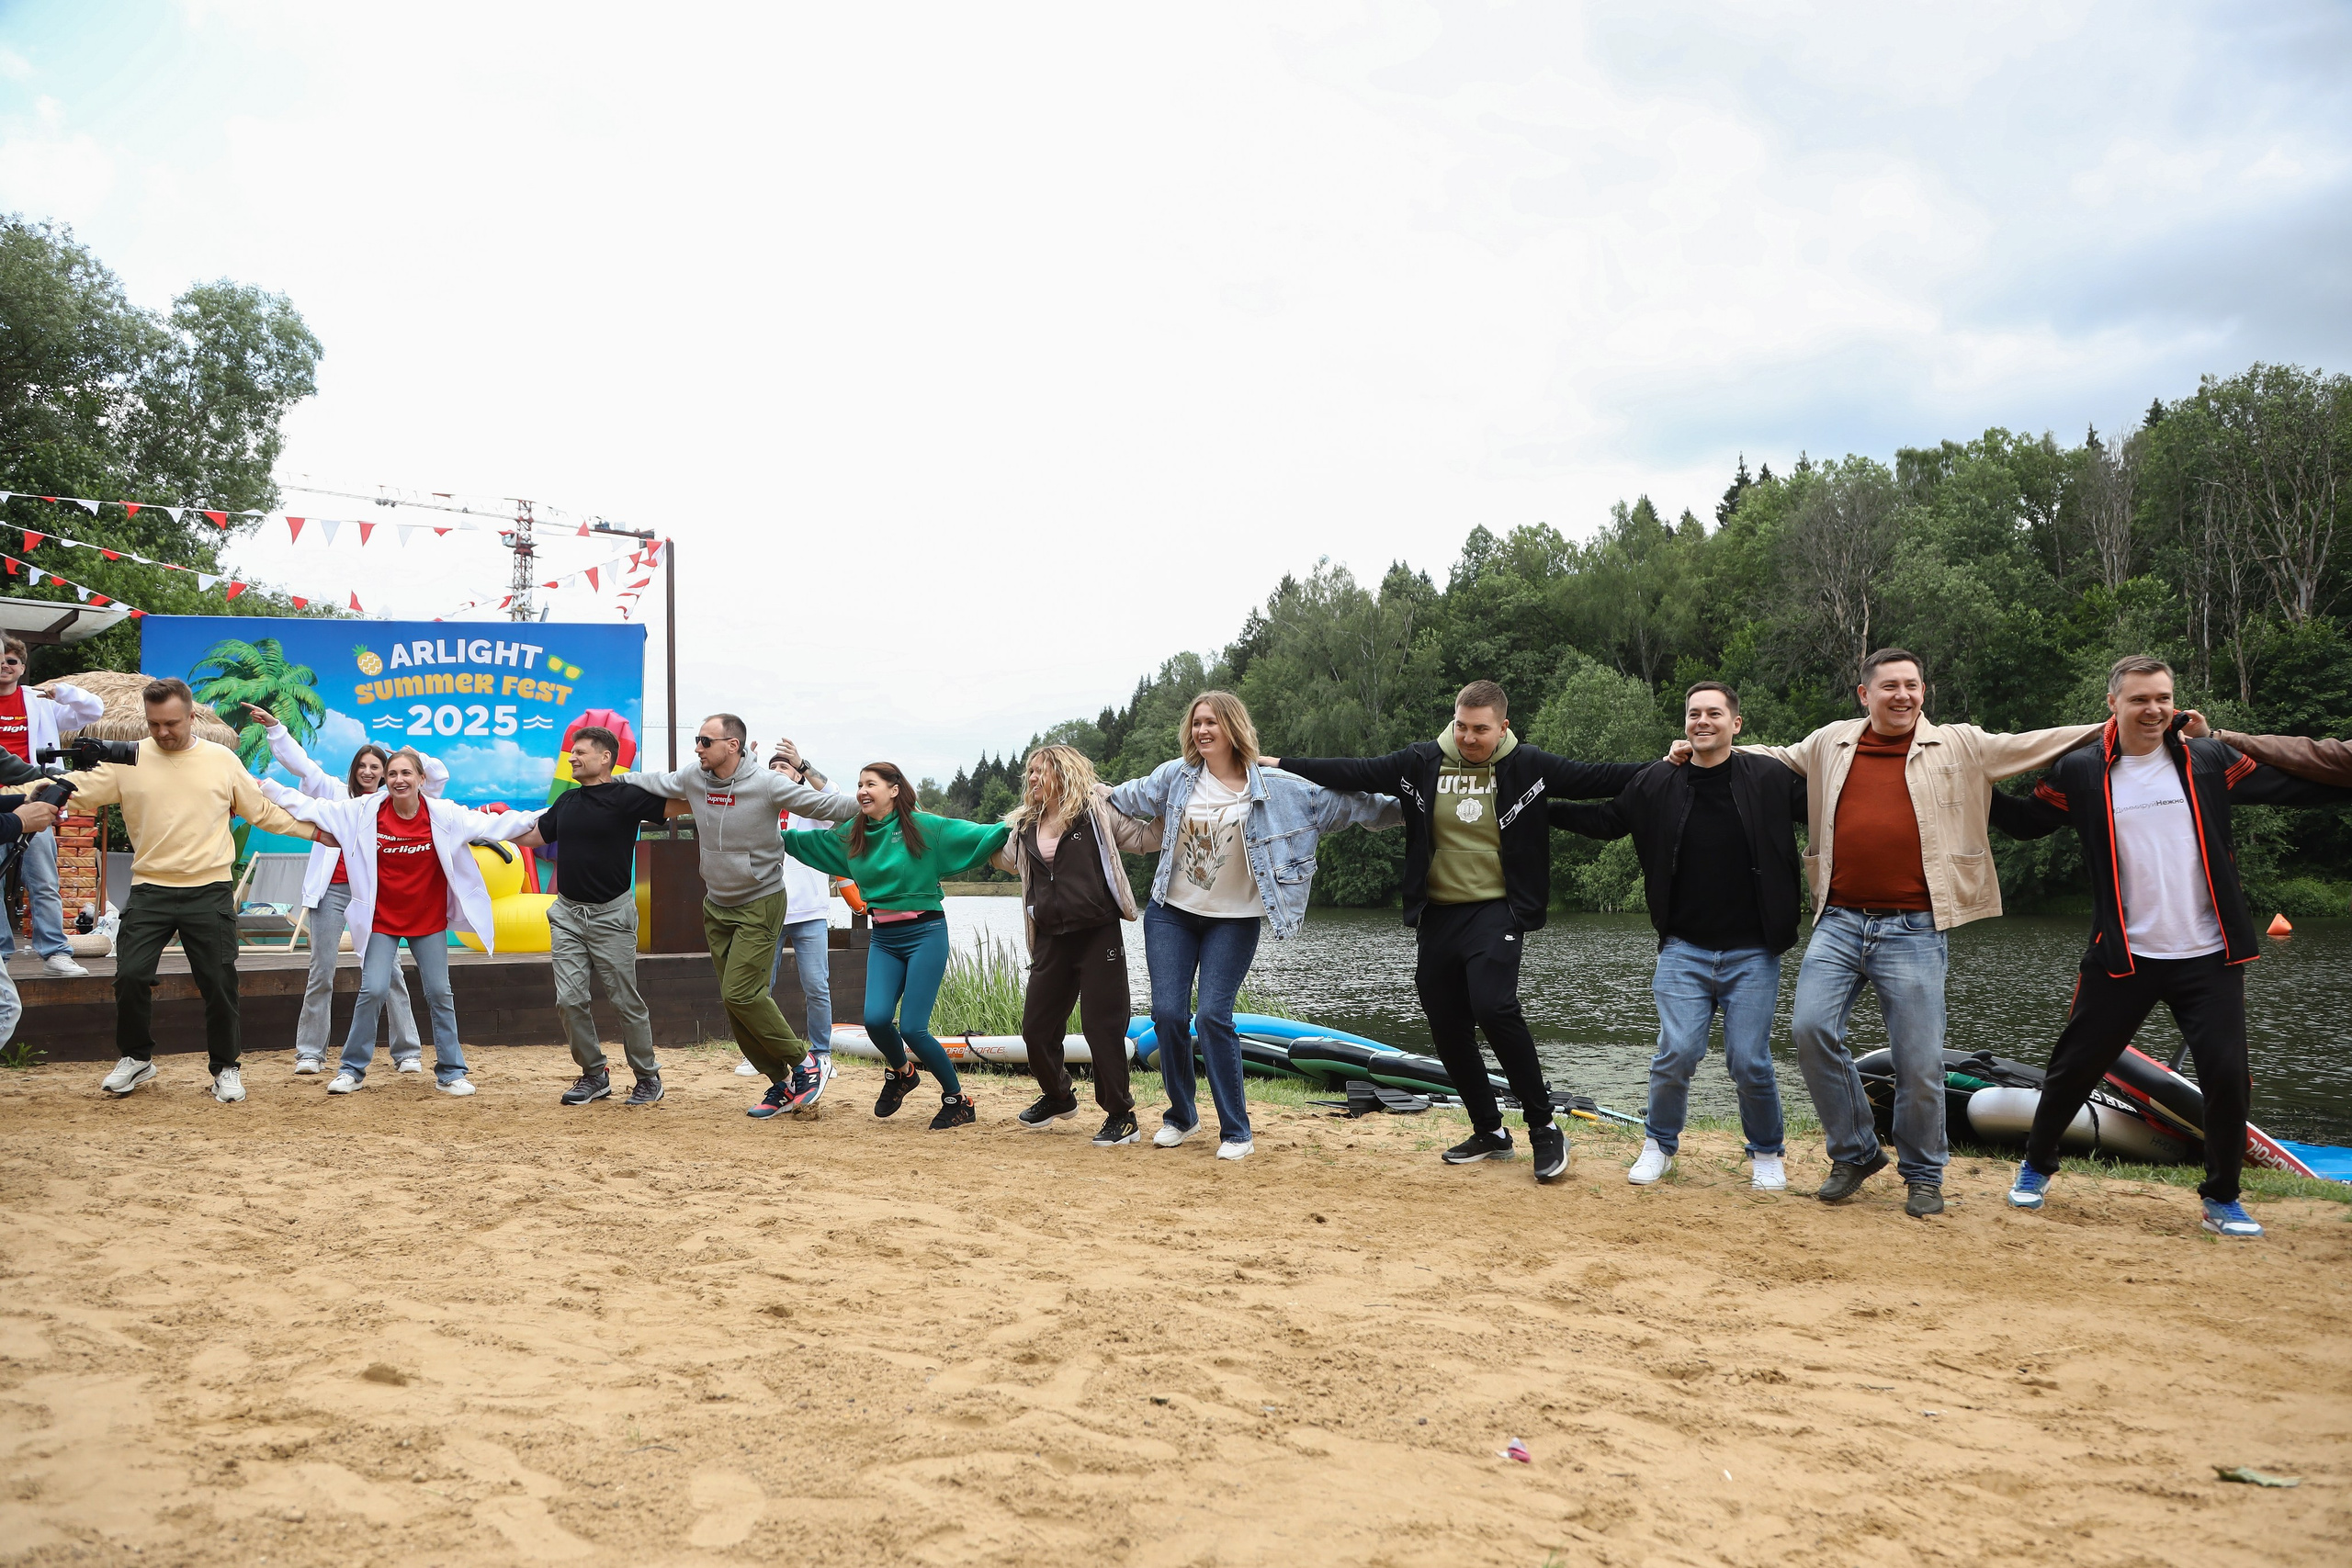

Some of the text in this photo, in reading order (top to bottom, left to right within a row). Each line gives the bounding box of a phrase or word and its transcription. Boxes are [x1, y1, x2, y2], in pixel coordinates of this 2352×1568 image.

[390, 638, 543, 669] ARLIGHT
[406, 705, 518, 736] 2025
[1436, 775, 1498, 795] UCLA
[707, 794, 733, 804] Supreme
[383, 842, 432, 854] arlight
